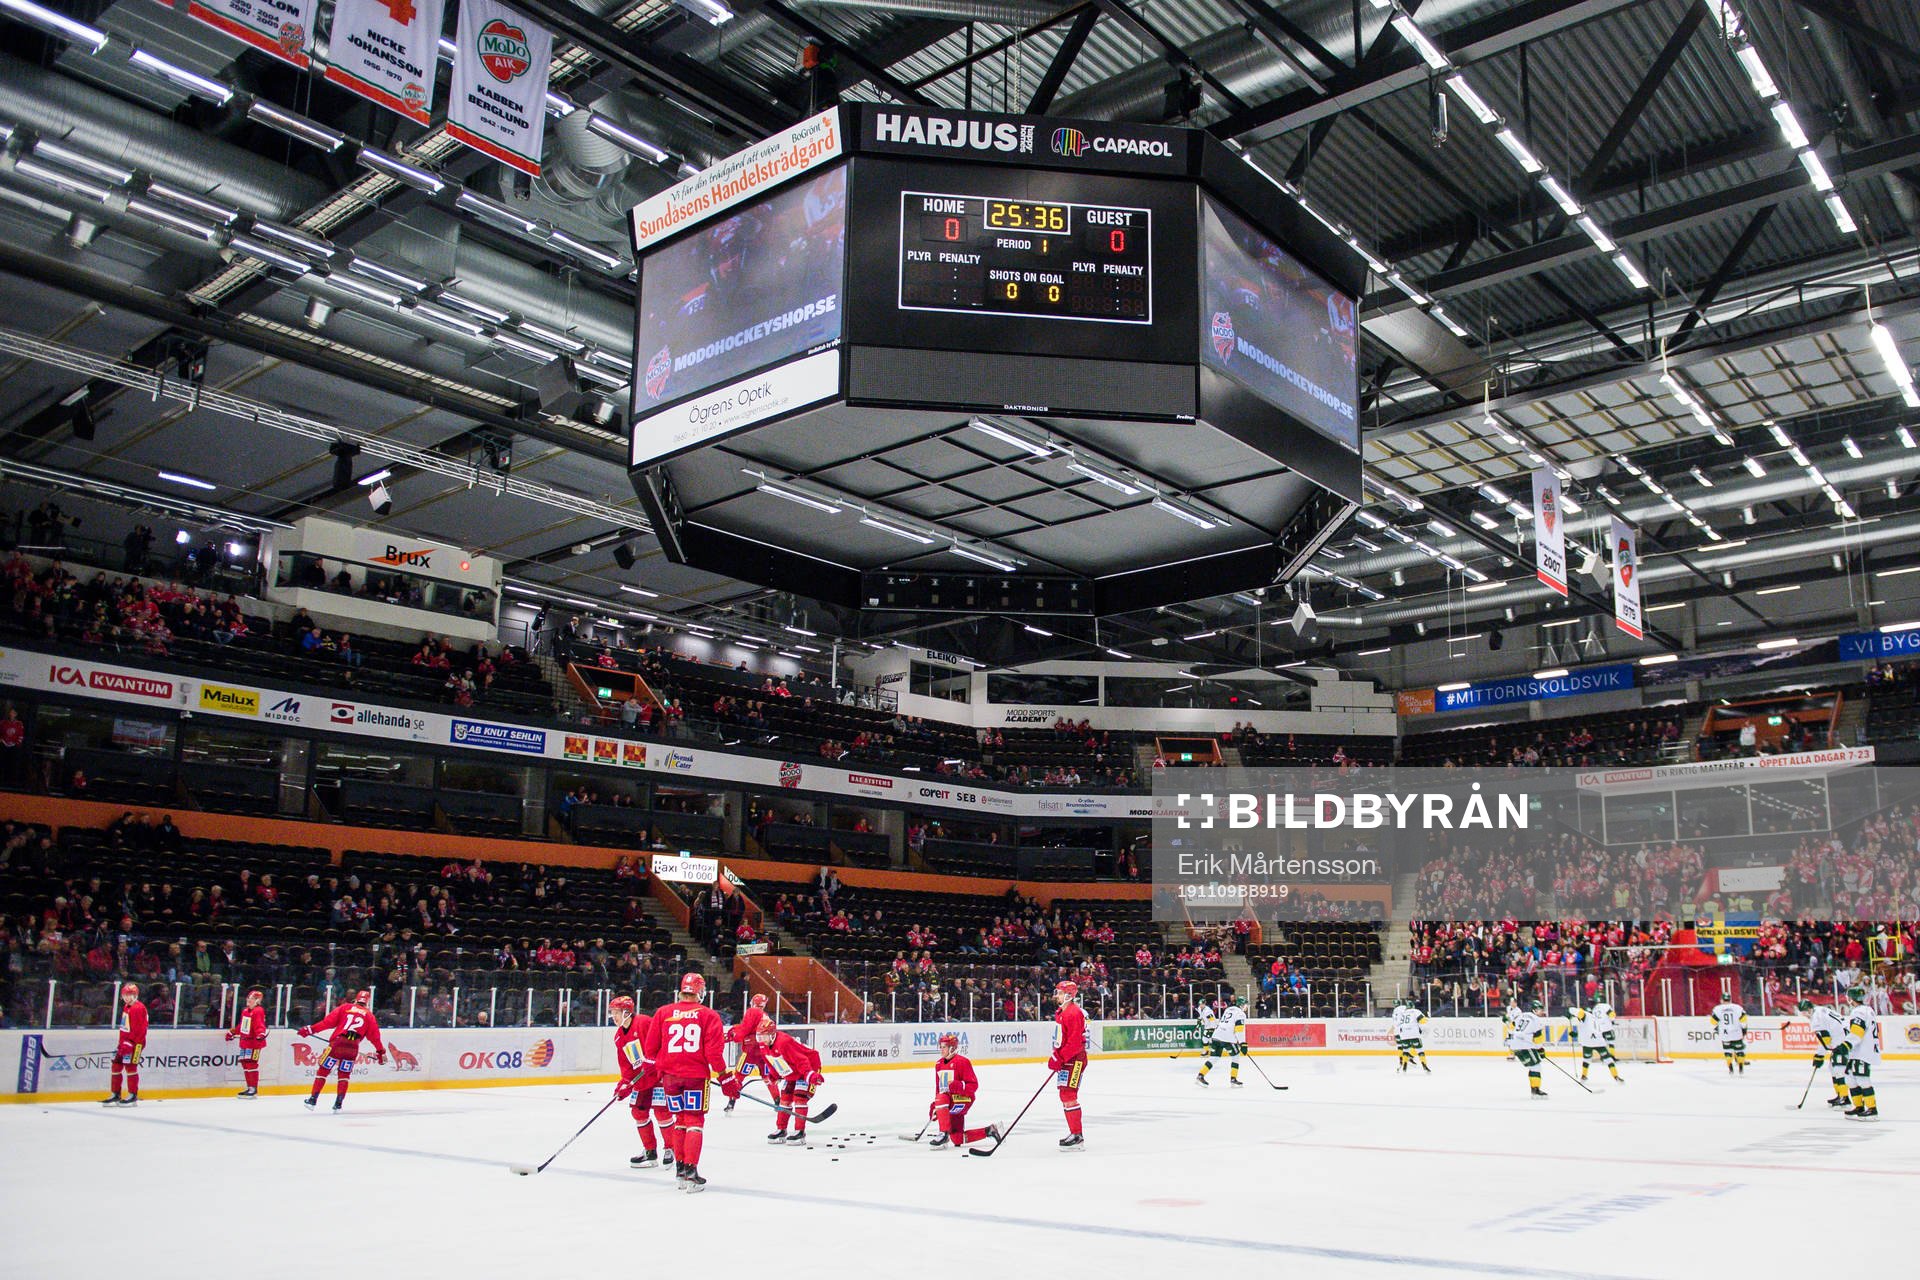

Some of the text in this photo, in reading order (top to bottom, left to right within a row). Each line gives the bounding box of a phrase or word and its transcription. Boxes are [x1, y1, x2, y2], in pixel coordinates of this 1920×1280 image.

[368, 29, 406, 55] NICKE
[347, 34, 422, 78] JOHANSSON
[495, 58, 515, 69] AIK
[478, 84, 523, 113] KABBEN
[468, 94, 529, 129] BERGLUND
[876, 113, 1018, 151] HARJUS
[1093, 137, 1172, 157] CAPAROL
[640, 128, 834, 239] Sundåsens Handelsträdgård
[923, 198, 965, 214] HOME
[991, 204, 1063, 229] 25:36
[1087, 210, 1132, 226] GUEST
[945, 218, 960, 240] 0
[997, 238, 1031, 250] PERIOD
[1111, 230, 1124, 252] 0
[907, 251, 981, 264] PLYR PENALTY
[989, 270, 1064, 284] SHOTS ON GOAL
[1072, 261, 1144, 276] PLYR PENALTY
[1007, 283, 1018, 299] 0
[1049, 285, 1060, 302] 0
[674, 295, 836, 372] MODOHOCKEYSHOP.SE
[1237, 336, 1354, 420] MODOHOCKEYSHOP.SE
[689, 382, 772, 424] Ögrens Optik
[386, 545, 430, 568] Brux
[1544, 554, 1561, 574] 2007
[927, 650, 957, 664] ELEIKO
[49, 665, 168, 695] ICA KVANTUM
[204, 688, 254, 706] Malux
[469, 725, 481, 734] AB
[484, 727, 508, 738] KNUT
[510, 731, 542, 742] SEHLIN
[673, 753, 694, 762] Svensk
[780, 769, 801, 777] MODO
[1580, 776, 1599, 786] ICA
[1606, 771, 1651, 782] KVANTUM
[1657, 770, 1667, 778] EN
[1669, 767, 1698, 776] RIKTIG
[1790, 755, 1812, 766] ALLA
[1814, 752, 1846, 763] DAGAR
[864, 778, 891, 787] SYSTEMS
[957, 792, 976, 803] SEB
[696, 872, 713, 881] 000
[673, 1009, 699, 1019] Brux
[1723, 1013, 1734, 1025] 91
[344, 1014, 364, 1032] 12
[668, 1023, 701, 1053] 29
[990, 1030, 1027, 1044] rexroth
[1338, 1034, 1396, 1043] Magnusso
[878, 1049, 888, 1057] AB
[1071, 1062, 1082, 1087] Malux
